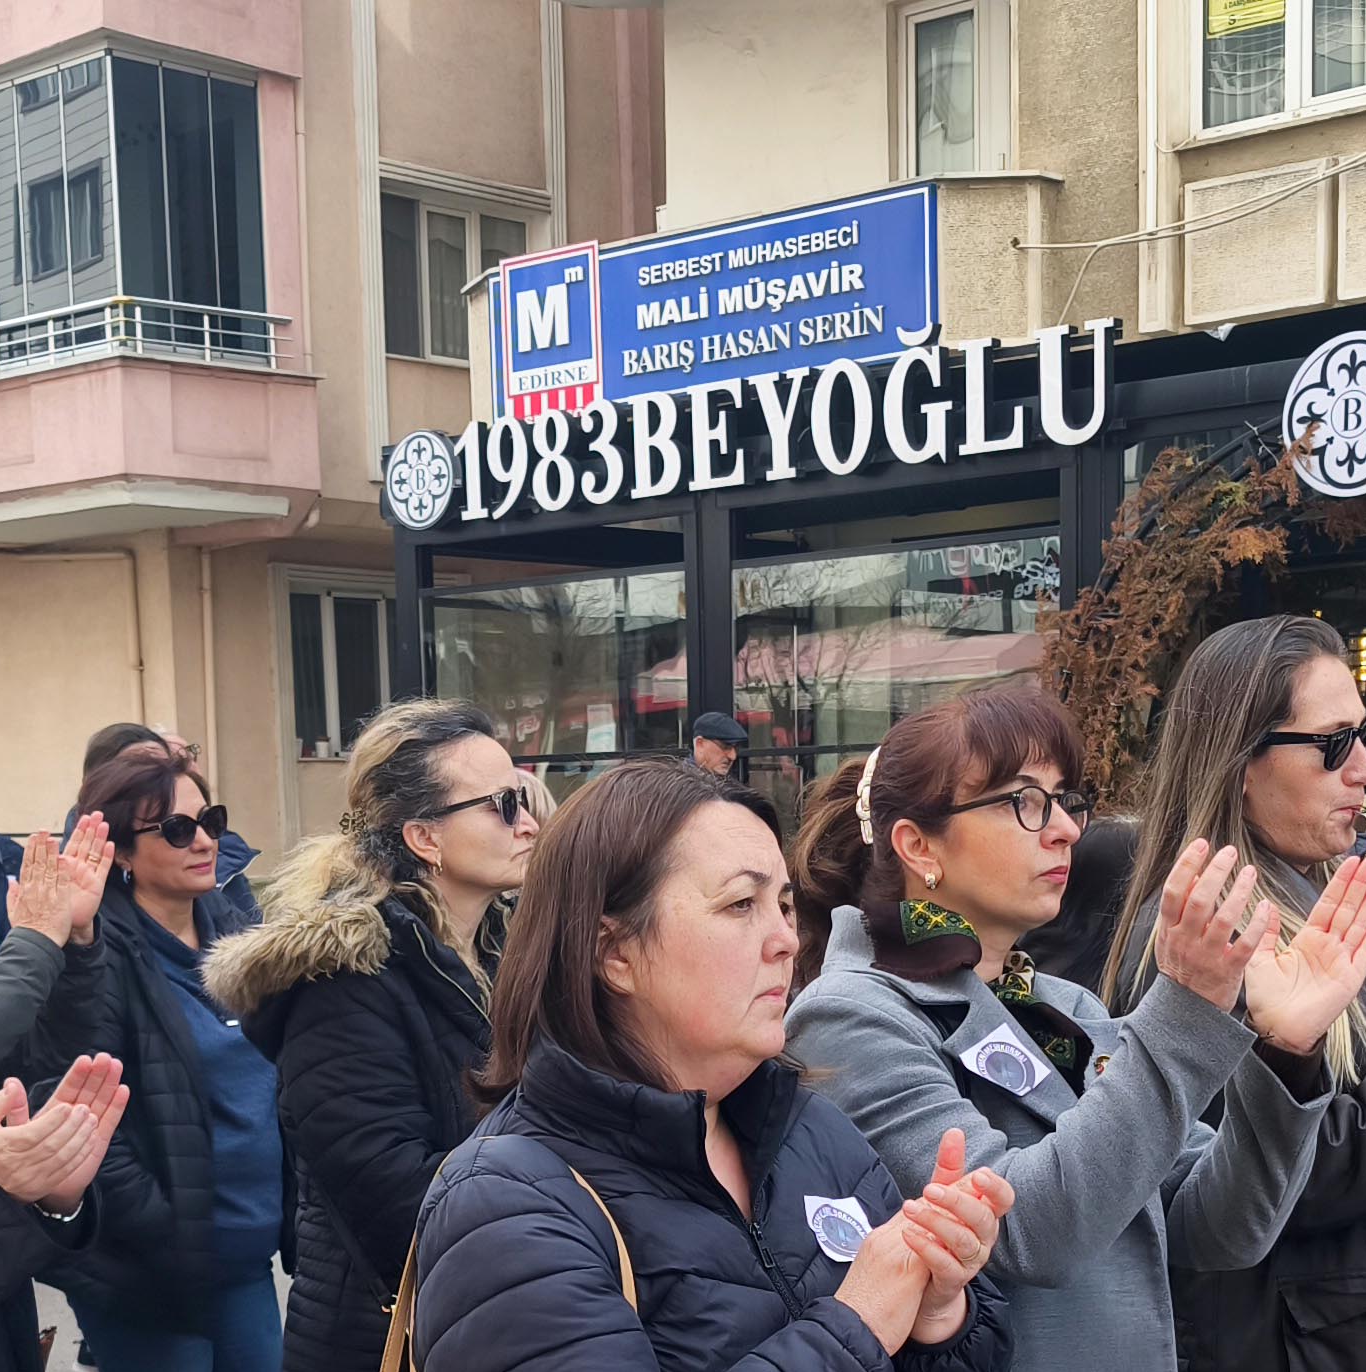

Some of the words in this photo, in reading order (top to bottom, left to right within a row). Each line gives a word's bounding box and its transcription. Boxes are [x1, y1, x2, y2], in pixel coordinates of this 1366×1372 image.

[638, 251, 724, 287] SERBEST
[727, 220, 860, 270] MUHASEBECİ
[636, 287, 710, 331] MALİ
[717, 261, 866, 315] MÜŞAVİR
[621, 340, 695, 378] BARIŞ
[700, 321, 793, 365] HASAN
[798, 302, 887, 347] SERİN
[517, 365, 590, 393] EDİRNE
[1341, 397, 1363, 432] B
[415, 468, 427, 491] B
